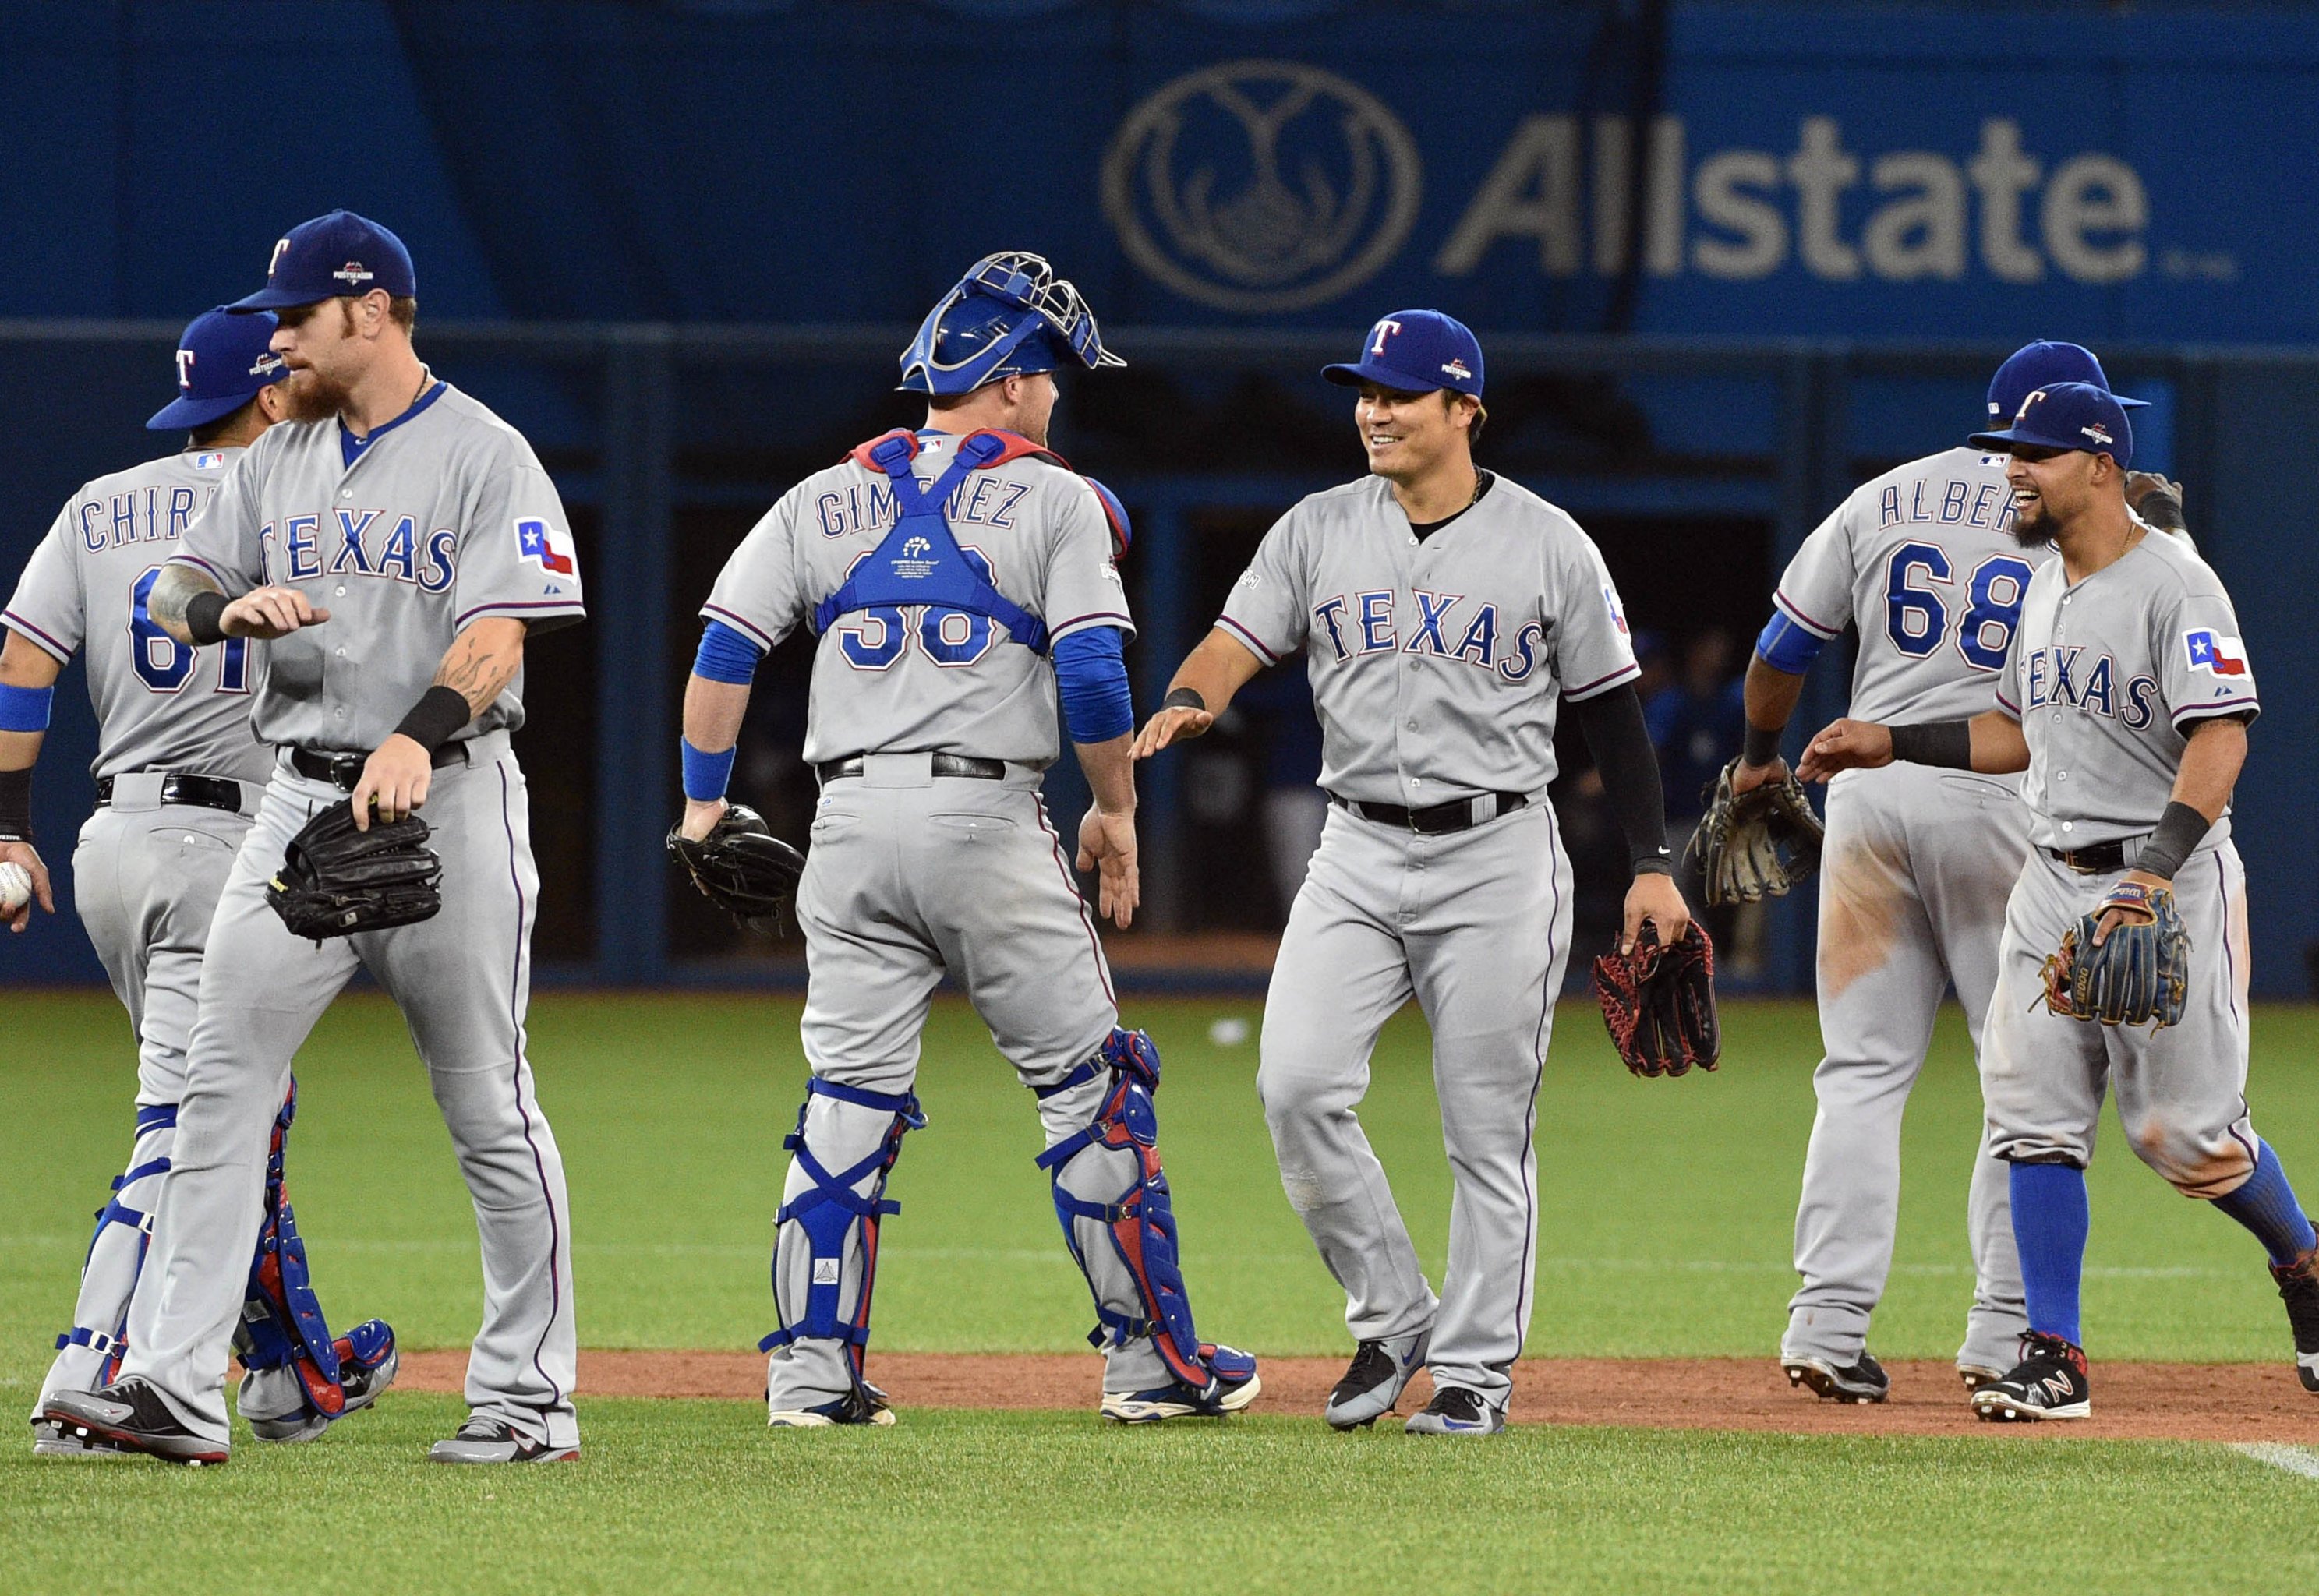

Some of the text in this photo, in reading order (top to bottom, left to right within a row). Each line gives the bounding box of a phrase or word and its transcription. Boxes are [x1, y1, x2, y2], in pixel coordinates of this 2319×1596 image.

[1430, 115, 2148, 284] Allstate
[268, 238, 291, 277] T
[176, 349, 196, 388] T
[1371, 320, 1402, 355] T
[2016, 390, 2047, 420] T
[79, 486, 218, 554] CHIR
[1313, 587, 1543, 682] TEXAS
[1882, 539, 2036, 672] 68
[2020, 644, 2159, 731] EXAS
